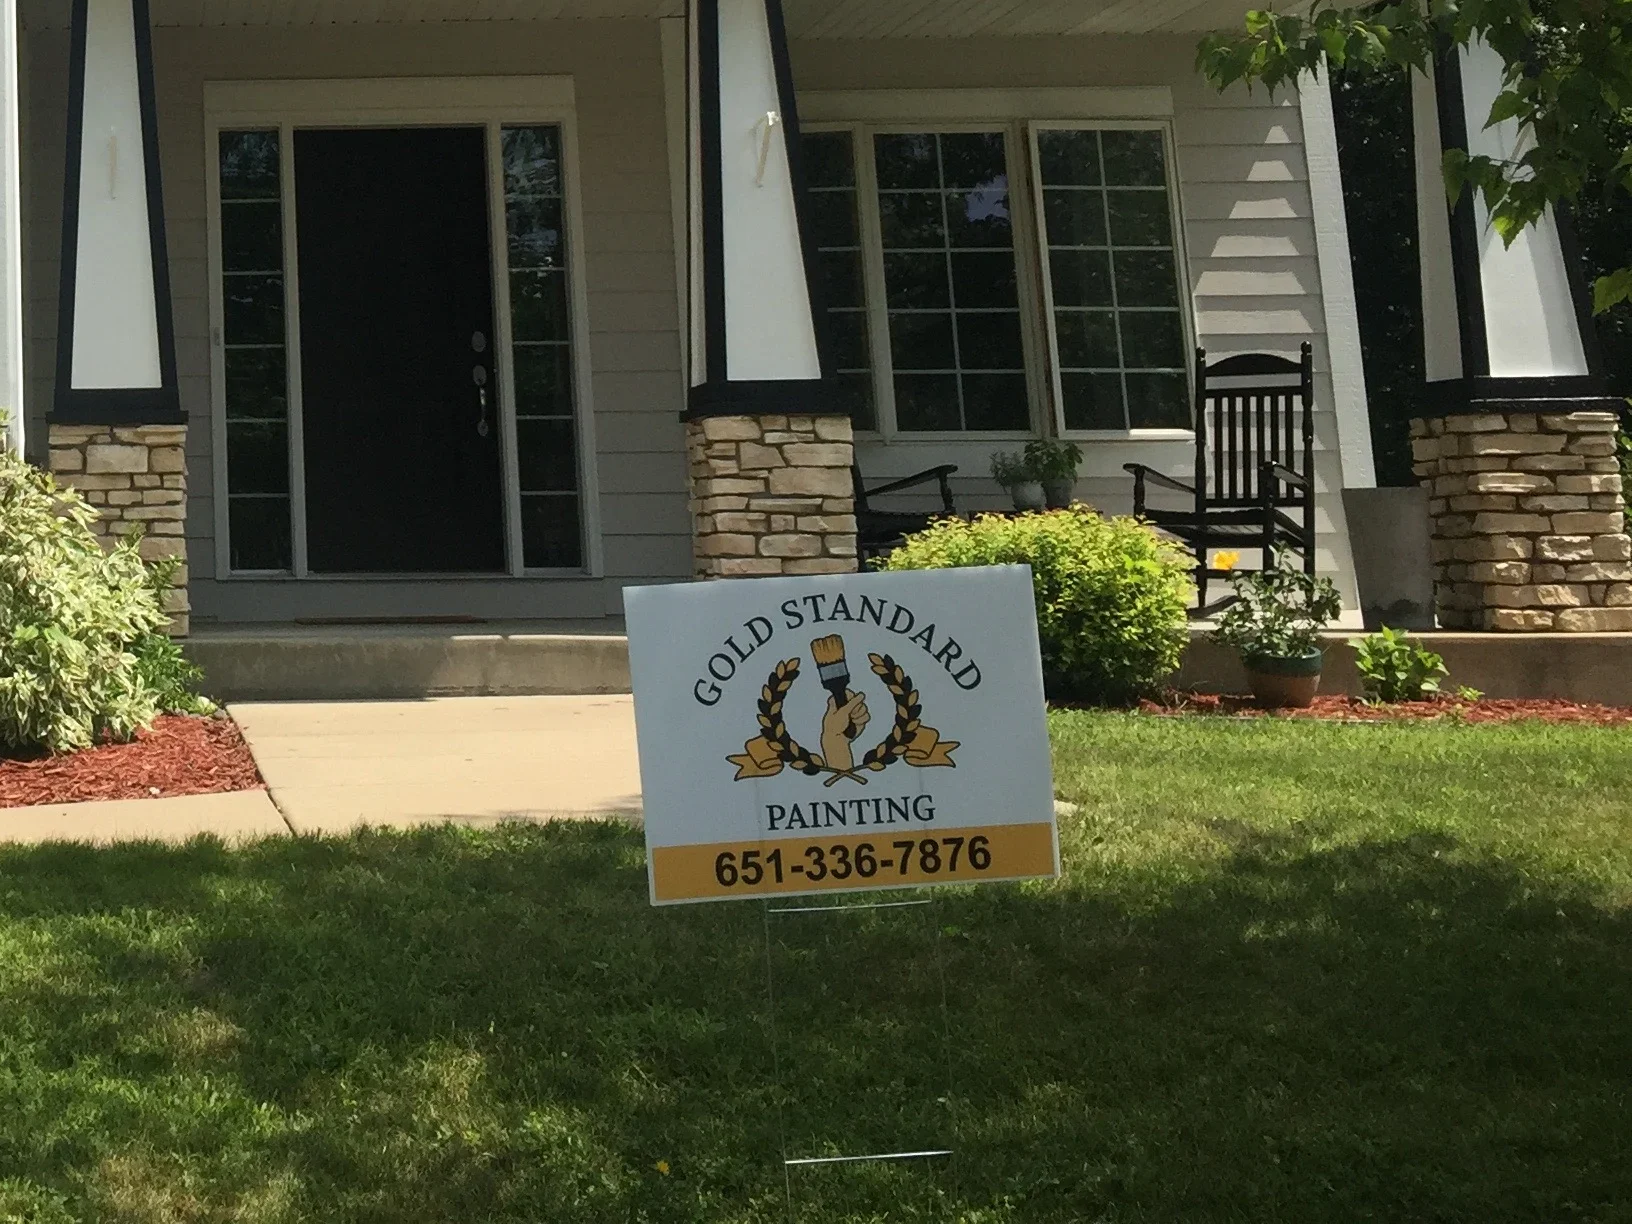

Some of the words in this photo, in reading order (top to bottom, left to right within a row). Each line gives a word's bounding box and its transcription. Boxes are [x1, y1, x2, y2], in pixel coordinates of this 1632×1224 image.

[693, 616, 774, 707] GOLD
[780, 593, 982, 691] STANDARD
[766, 794, 936, 831] PAINTING
[715, 835, 992, 887] 651-336-7876
